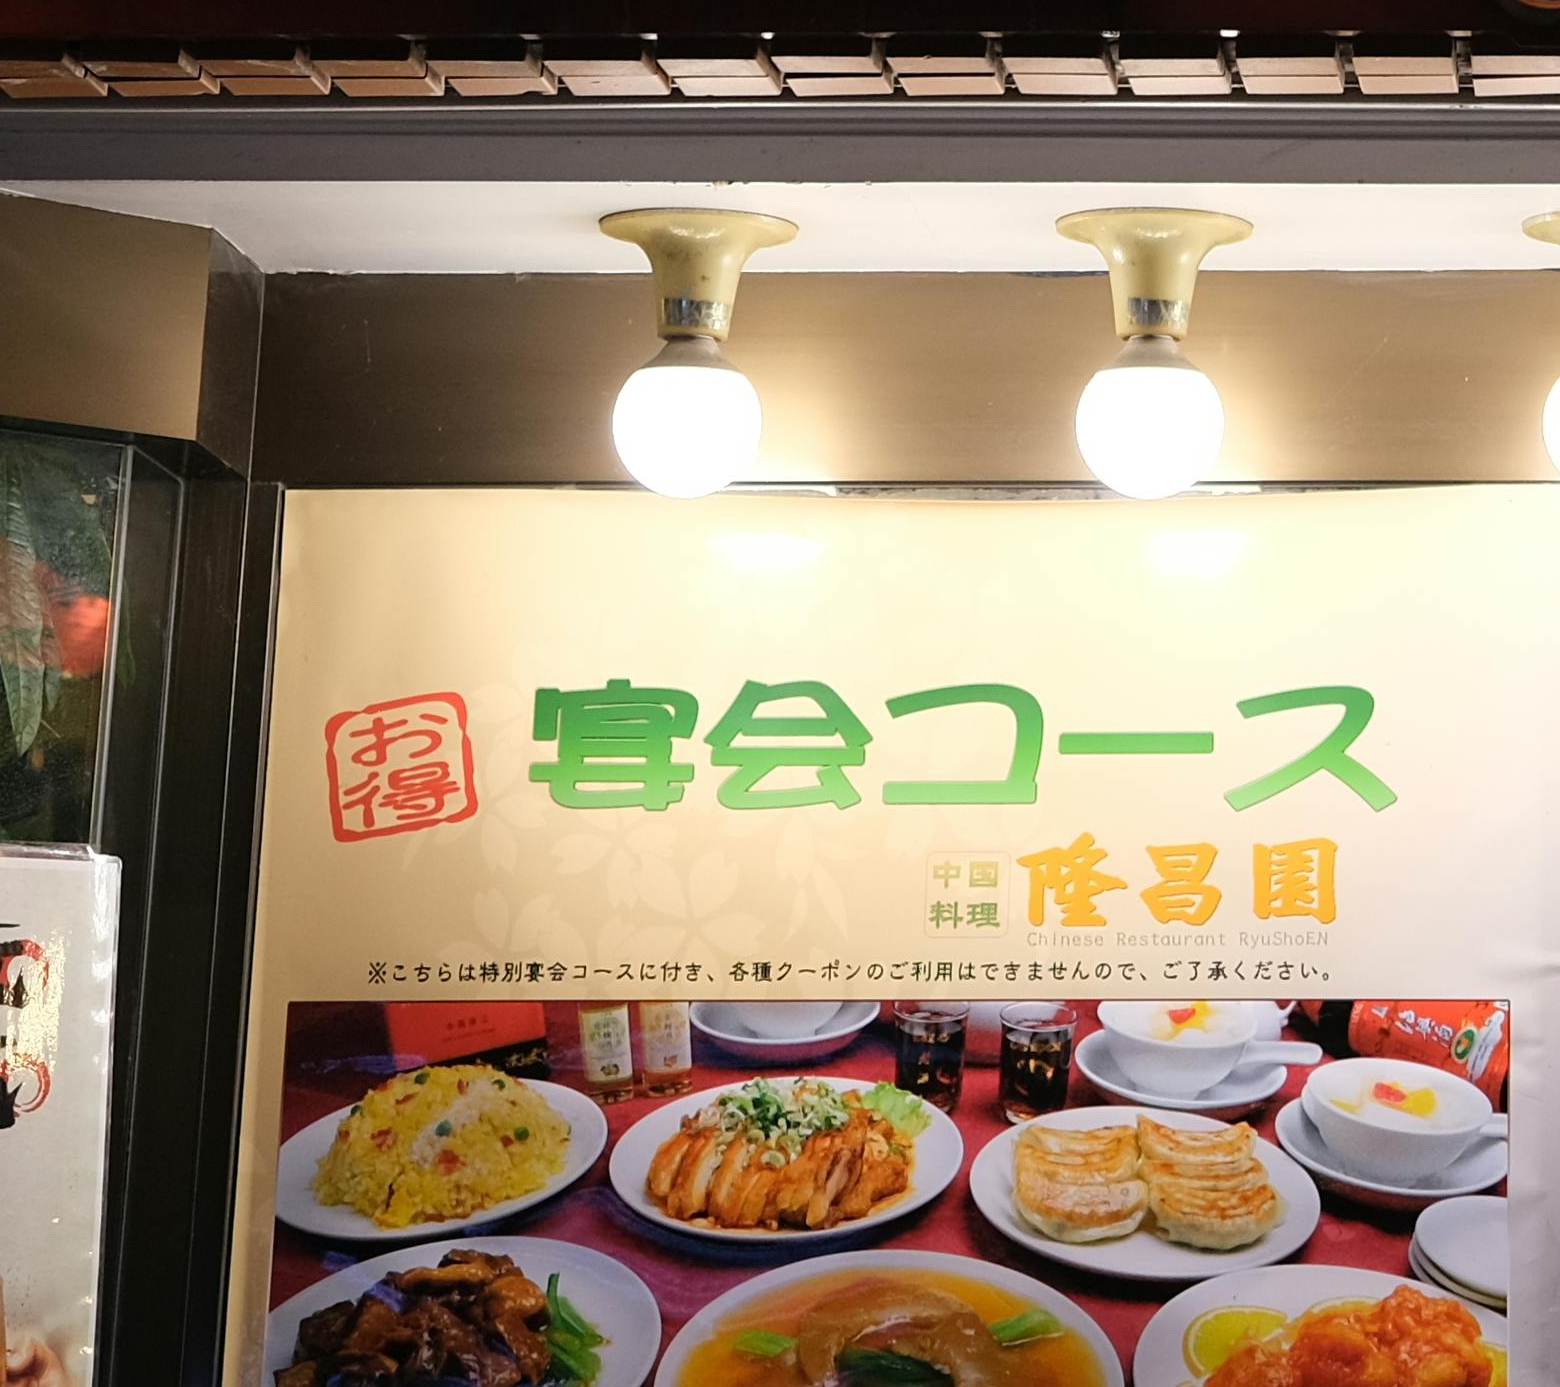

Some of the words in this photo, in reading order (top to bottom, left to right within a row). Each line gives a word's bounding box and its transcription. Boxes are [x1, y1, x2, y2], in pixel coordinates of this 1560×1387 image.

[342, 712, 460, 828] お得
[529, 678, 1398, 812] 宴会コース
[1016, 831, 1339, 927] 隆昌園
[1026, 931, 1104, 948] Chinese
[1116, 931, 1227, 947] Restaurant
[1239, 930, 1329, 950] RyuShoEN
